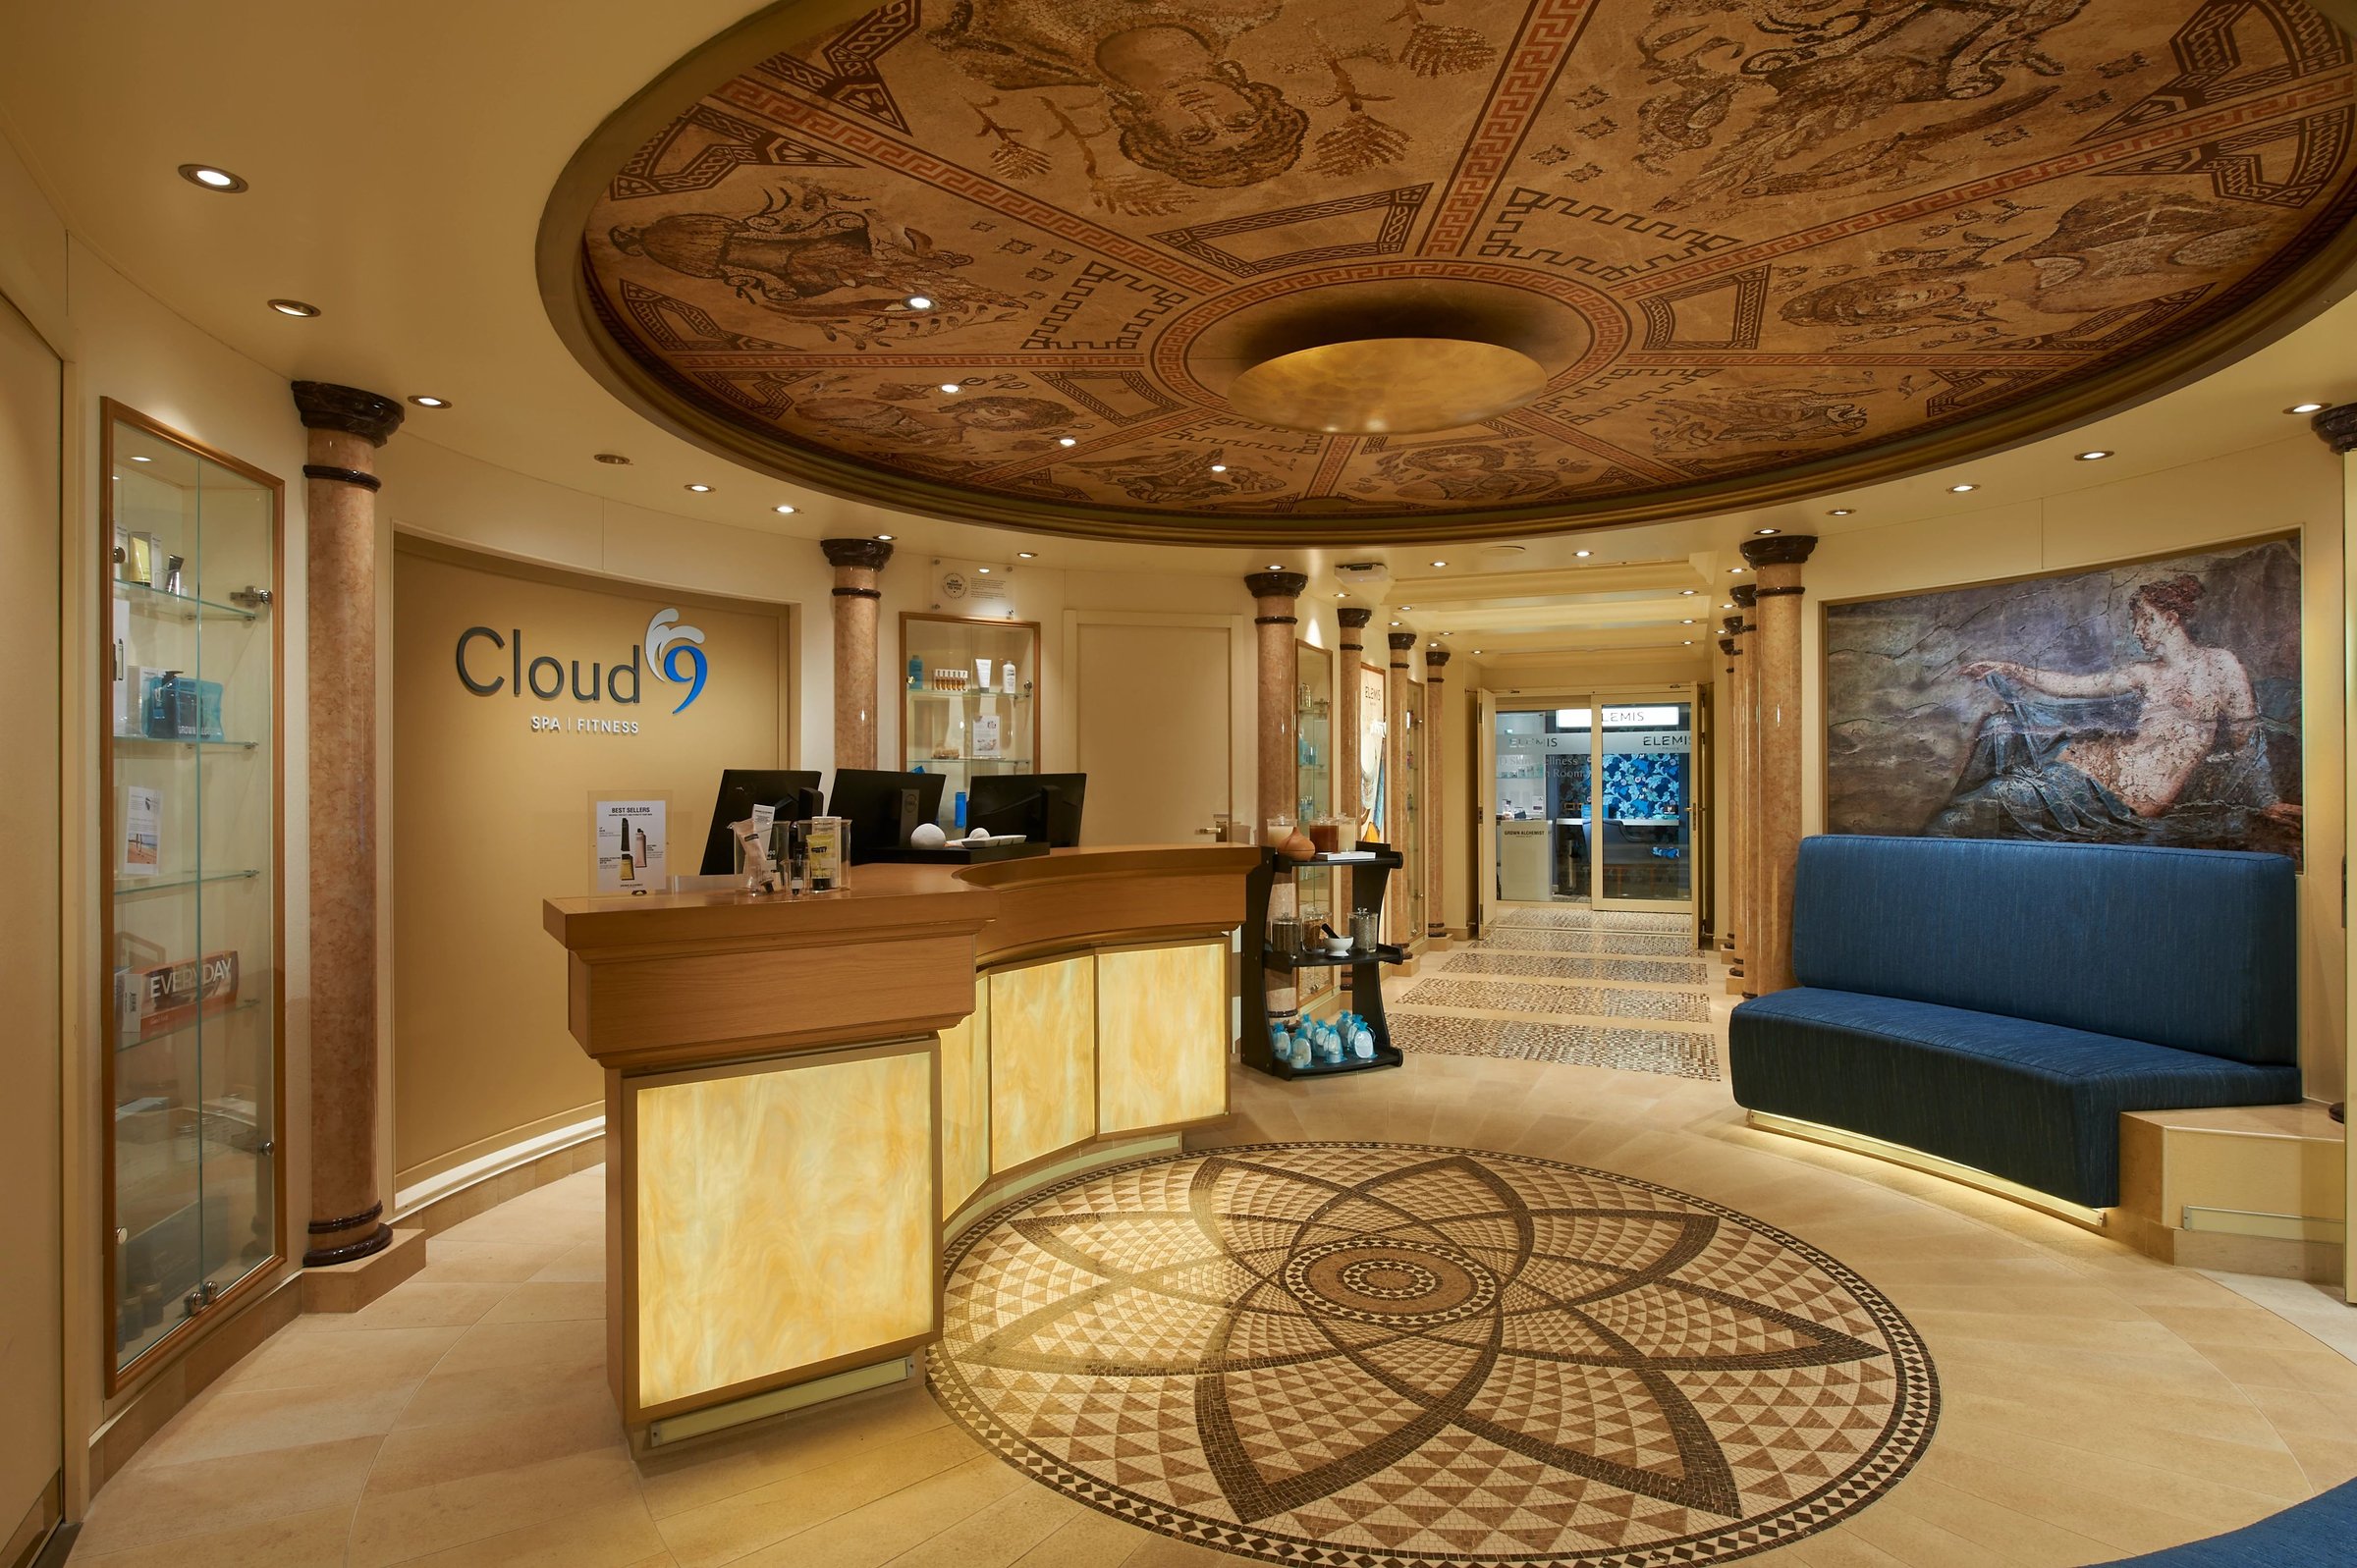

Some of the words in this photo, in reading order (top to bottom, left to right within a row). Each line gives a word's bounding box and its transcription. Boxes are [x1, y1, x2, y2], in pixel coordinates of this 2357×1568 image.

[456, 625, 640, 703] Cloud
[663, 645, 708, 715] 9
[1602, 711, 1644, 723] LEMIS
[532, 716, 561, 730] SPA
[577, 718, 639, 733] FITNESS
[1545, 755, 1579, 766] ellness
[1553, 768, 1583, 778] Room
